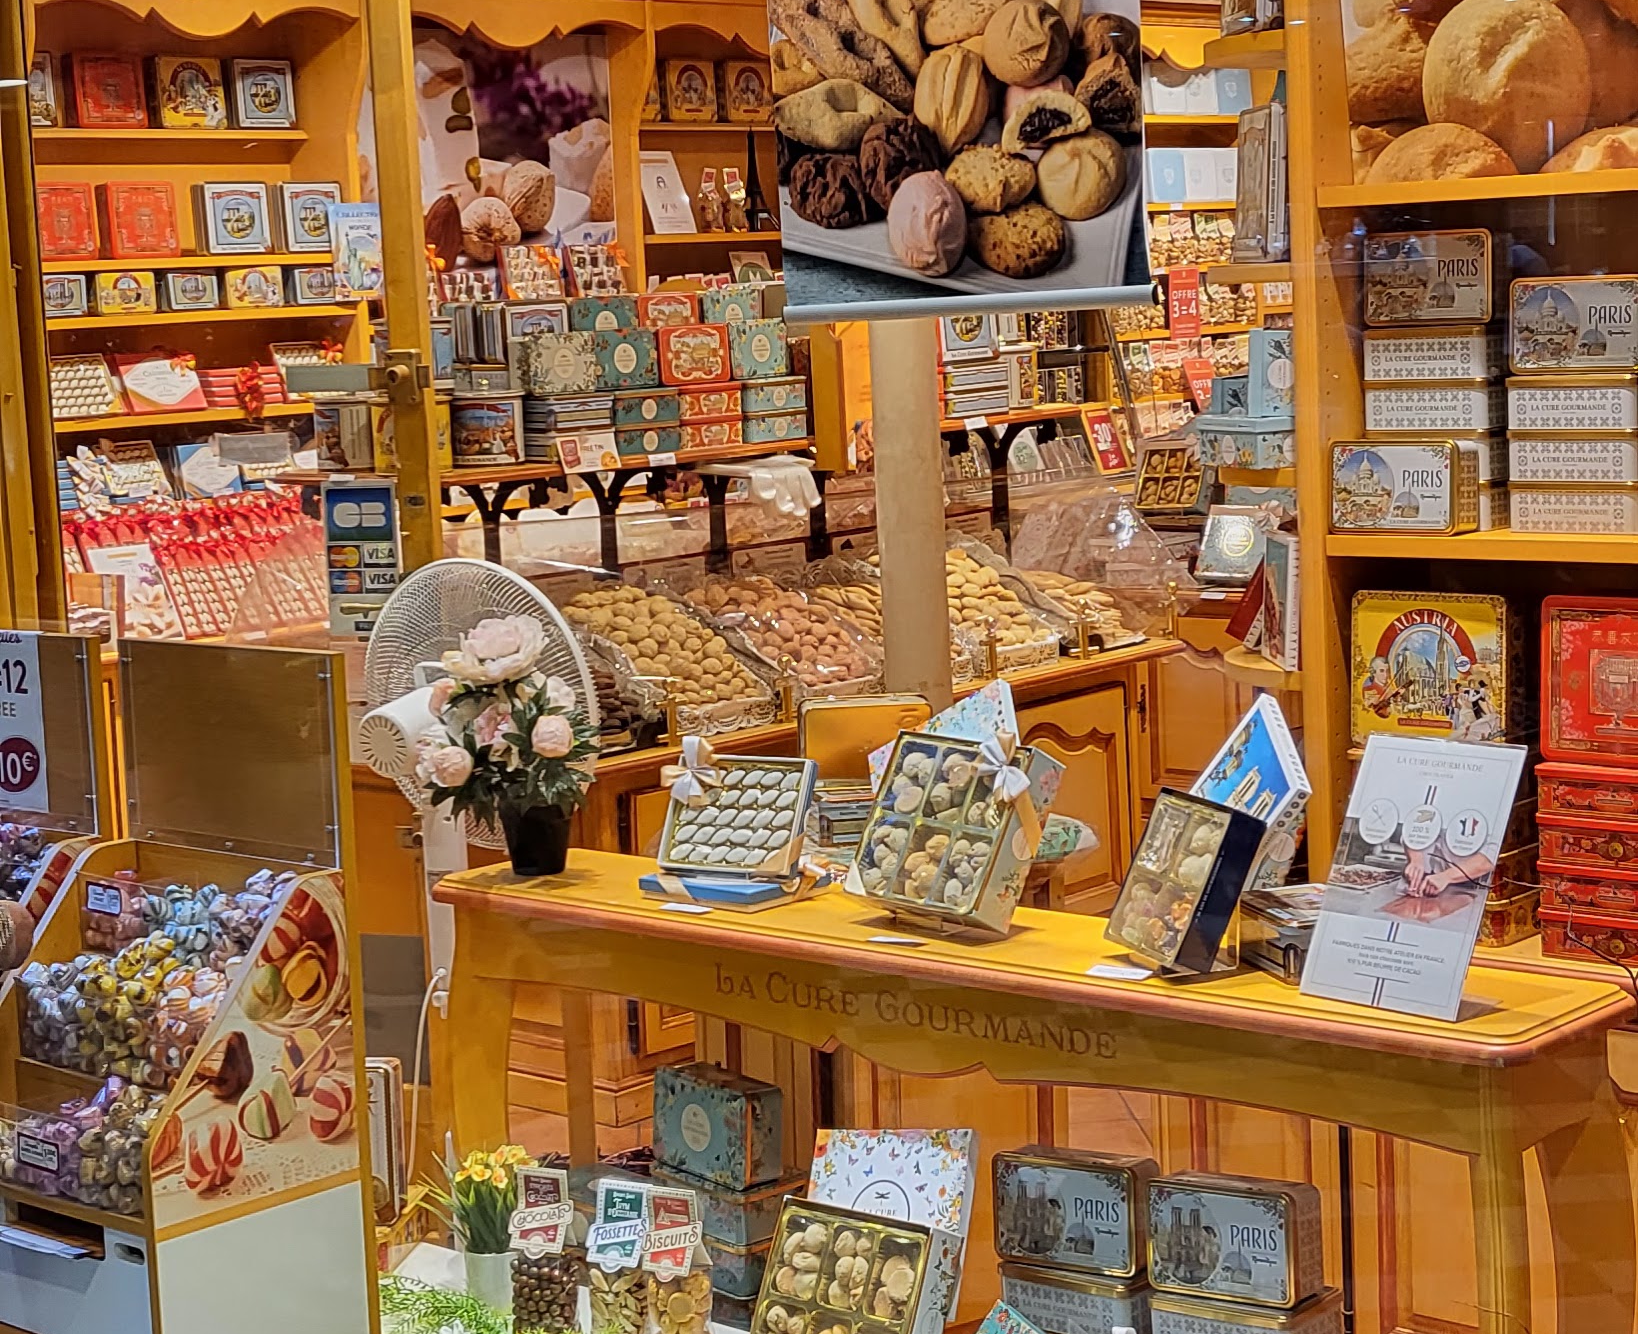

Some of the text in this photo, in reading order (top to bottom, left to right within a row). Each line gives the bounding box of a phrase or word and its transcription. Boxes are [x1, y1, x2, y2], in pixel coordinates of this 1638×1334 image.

[1437, 258, 1479, 278] PARIS
[1172, 289, 1197, 299] OFFRE
[1172, 300, 1197, 318] 3=4
[1588, 305, 1632, 325] PARIS
[1385, 354, 1457, 363] LA CURE GOURMANDE
[1386, 404, 1458, 413] LA CURE GOURMANDE
[1531, 404, 1540, 412] LA
[1532, 456, 1541, 464] LA
[1562, 456, 1608, 464] GOURMANDE
[1402, 469, 1443, 488] PARIS
[333, 502, 386, 528] CB
[366, 547, 395, 560] VISA
[369, 573, 397, 585] VISA
[1393, 611, 1458, 637] AUSTRIA
[0, 658, 28, 695] 12
[0, 701, 17, 717] EE
[1397, 756, 1484, 773] LA CURE GOURMANDE
[765, 971, 860, 1016] CURE
[874, 990, 1118, 1060] GOURMANDE
[1074, 1197, 1120, 1223] PARIS
[593, 1218, 648, 1245] FOSSETTES
[643, 1225, 699, 1253] BISCUITS
[1230, 1224, 1278, 1252] PARIS
